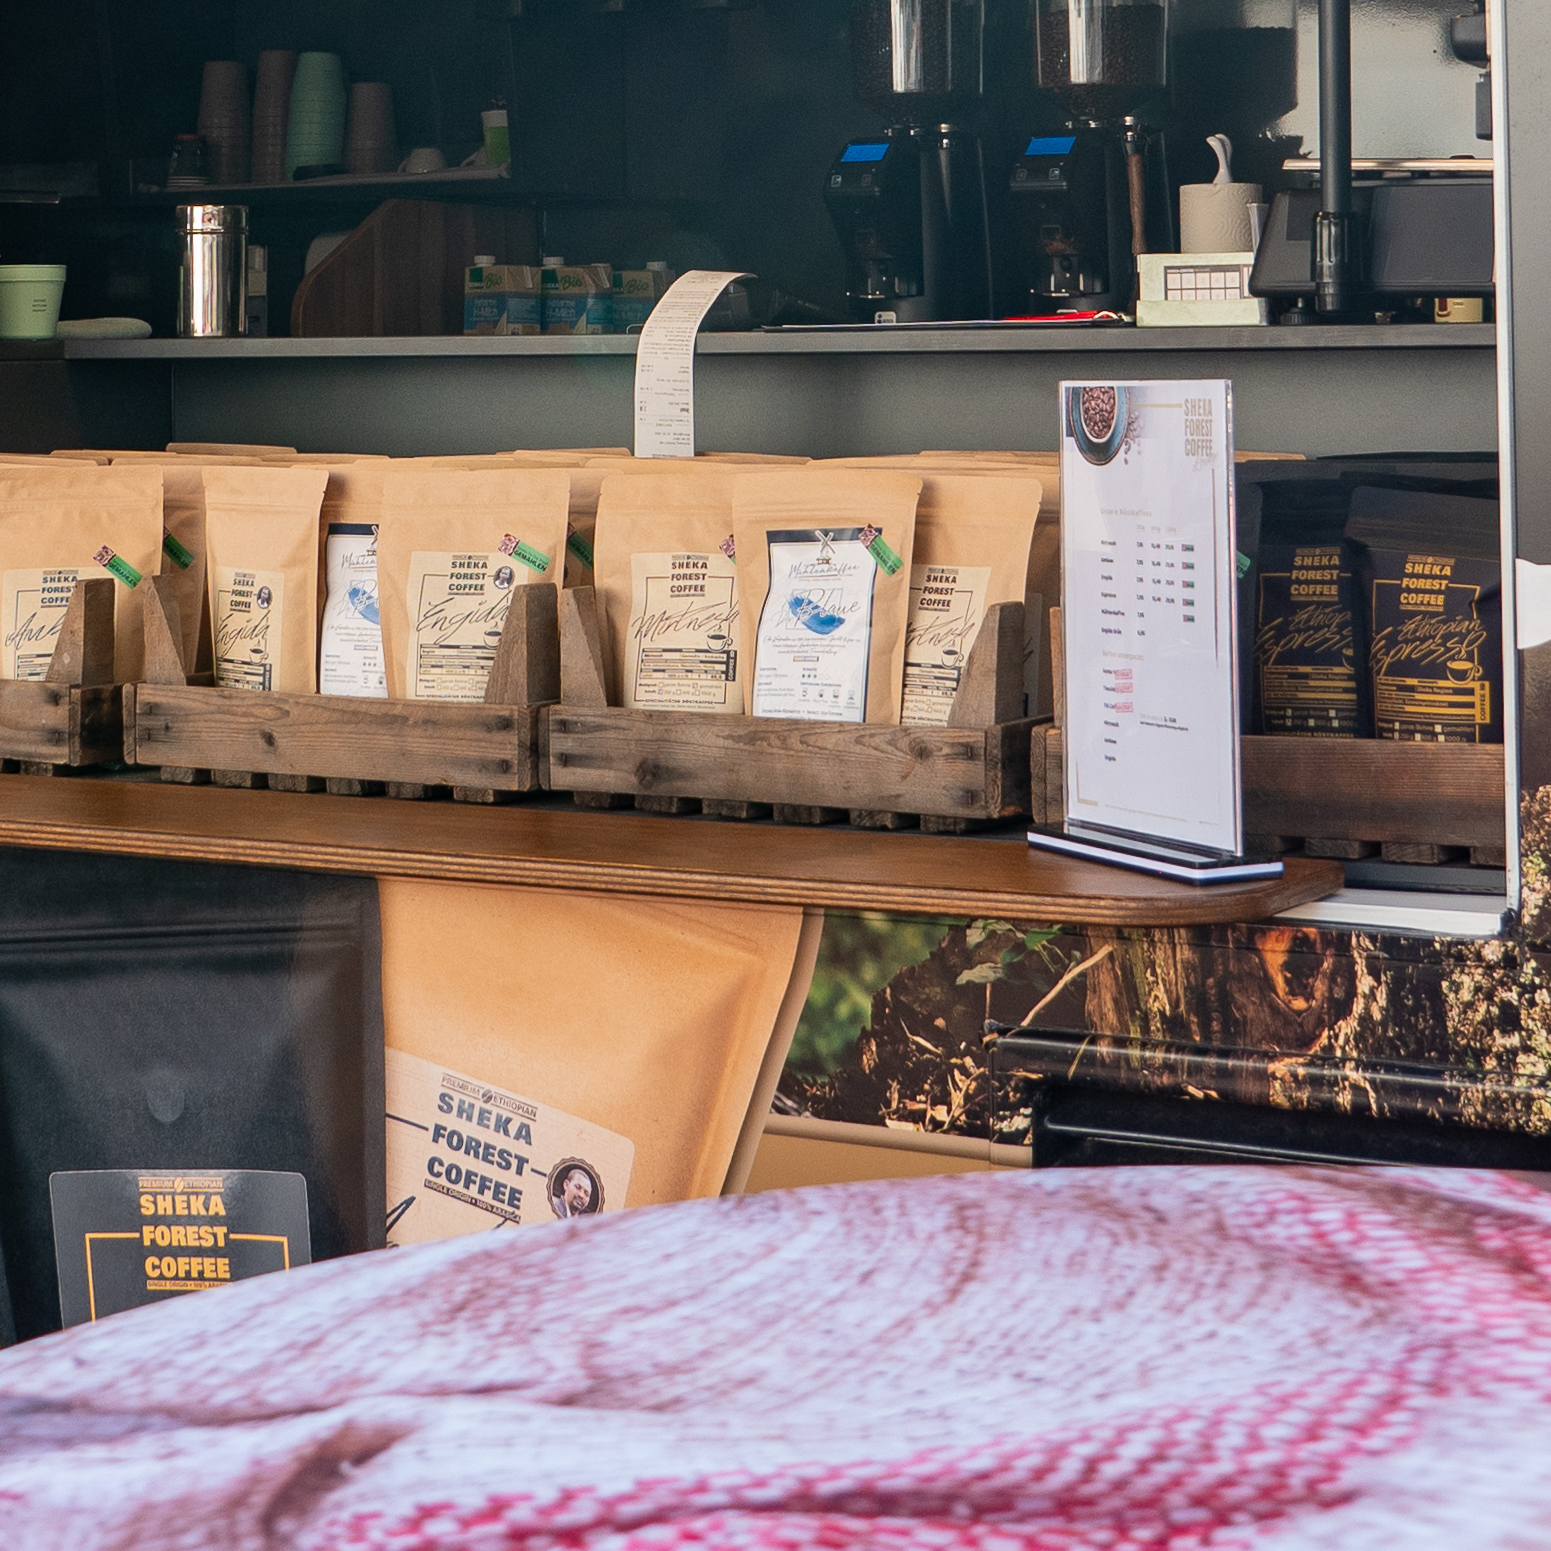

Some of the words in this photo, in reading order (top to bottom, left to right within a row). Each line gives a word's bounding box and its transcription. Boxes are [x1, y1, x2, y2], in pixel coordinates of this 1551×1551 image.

[484, 273, 503, 289] Bio
[560, 274, 583, 291] Bio
[625, 279, 649, 294] Bio
[1184, 398, 1213, 417] SHEKA
[1184, 418, 1213, 437] FOREST
[1185, 438, 1213, 457] COFFEE
[451, 560, 489, 570] SHEKA
[513, 549, 547, 573] GEMAHLEN
[671, 561, 708, 570] SHEKA
[870, 544, 897, 575] GEMAHLEN
[1293, 555, 1340, 566] SHEKA
[1291, 569, 1339, 581] FOREST
[1404, 563, 1452, 576] SHEKA
[42, 575, 78, 584] SHEKA
[232, 578, 255, 587] SHEKA
[449, 572, 487, 581] FOREST
[671, 573, 708, 582] FOREST
[925, 574, 957, 584] SHEKA
[448, 583, 485, 592] COFFEE
[670, 585, 706, 593] COFFEE
[1290, 584, 1339, 595] COFFEE
[1401, 578, 1449, 590] FOREST
[230, 589, 253, 598] FOREST
[922, 586, 956, 596] FOREST
[230, 599, 252, 608] COFFEE
[919, 598, 952, 608] COFFEE
[1400, 593, 1445, 606] COFFEE
[1397, 614, 1485, 641] Ethiopian
[1369, 626, 1487, 677] Espresso
[1479, 692, 1487, 721] COFFEE
[442, 1075, 480, 1097] PREMIUM
[493, 1094, 537, 1119] ETHIOPIAN
[437, 1091, 533, 1147] SHEKA
[431, 1123, 530, 1178] FOREST
[139, 1179, 174, 1189] PREMIUM
[183, 1179, 224, 1189] ETHIOPIAN
[426, 1155, 524, 1211] COFFEE
[140, 1194, 227, 1217] SHEKA
[475, 1196, 493, 1211] 100%
[492, 1202, 522, 1223] ARABICA
[142, 1225, 228, 1248] FOREST
[144, 1256, 231, 1279] COFFEE
